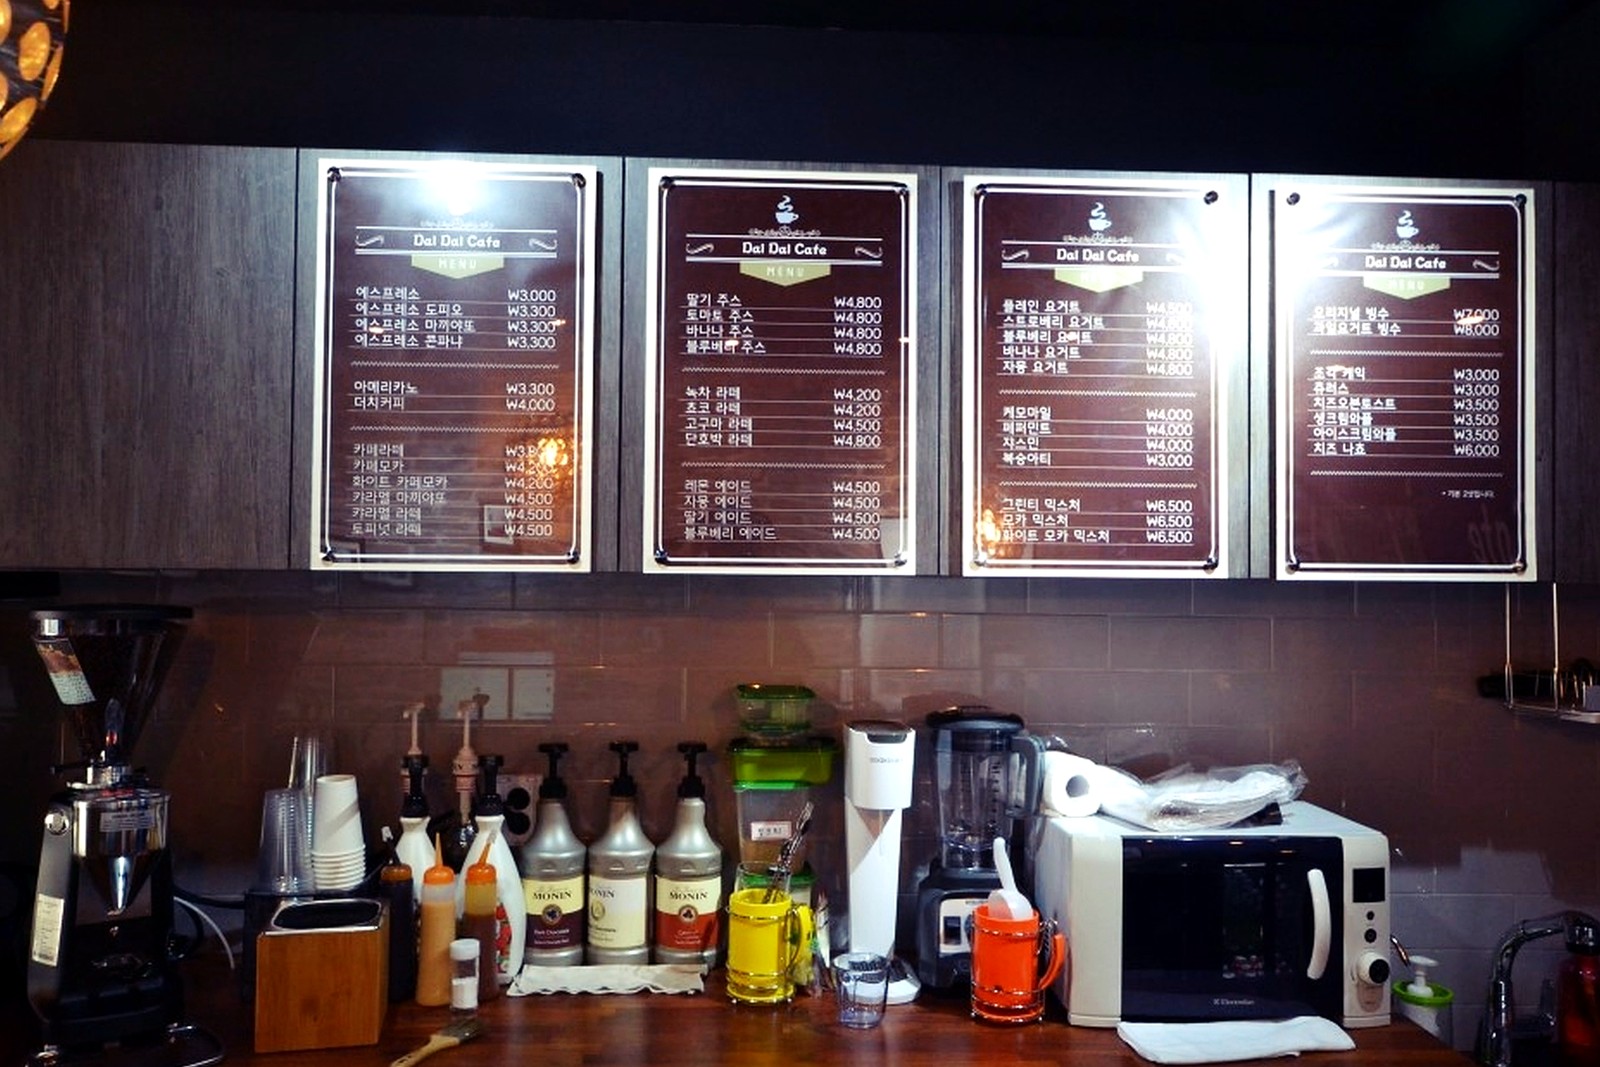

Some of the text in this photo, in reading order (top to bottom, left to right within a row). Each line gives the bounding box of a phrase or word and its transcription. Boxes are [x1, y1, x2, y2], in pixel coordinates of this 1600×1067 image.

[414, 235, 501, 248] Dal Dal Cafe
[742, 242, 827, 255] Dal Dal Cafe
[1057, 249, 1139, 262] Dal Dal Cafe
[438, 258, 477, 269] MENU
[1365, 256, 1446, 269] Dal Dal Cafe
[766, 267, 805, 277] MENU
[355, 286, 420, 301] 에스프레소
[687, 293, 711, 307] 딸기
[717, 294, 742, 307] 주스
[355, 302, 420, 317] 에스프레소
[425, 304, 464, 317] 도피오
[686, 309, 723, 322] 토마토
[729, 310, 754, 323] 주스
[1365, 307, 1389, 320] 빙수
[686, 325, 723, 338] 바나나
[729, 325, 754, 338] 주스
[1378, 322, 1401, 336] 빙수
[354, 333, 419, 348] 에스프레소
[741, 341, 766, 354] 주스
[1002, 346, 1040, 359] 바나나
[1002, 361, 1027, 374] 자몽
[354, 380, 418, 395] 아메리카노
[354, 396, 405, 410] 더치커피
[685, 418, 722, 431] 고구마
[685, 433, 722, 447] 단호박
[1313, 442, 1337, 455] 치즈
[1002, 452, 1051, 466] 복숭아티
[684, 479, 709, 493] 레몬
[715, 480, 752, 493] 에이드
[684, 495, 709, 508] 자몽
[715, 495, 752, 508] 에이드
[1002, 499, 1039, 512] 그린티
[684, 511, 709, 524] 딸기
[715, 511, 752, 524] 에이드
[1002, 515, 1027, 527] 모카
[684, 526, 733, 540] 블루베리
[739, 527, 777, 540] 에이드
[1044, 530, 1069, 542] 모카
[533, 891, 572, 900] MONIN
[670, 892, 708, 900] MONIN
